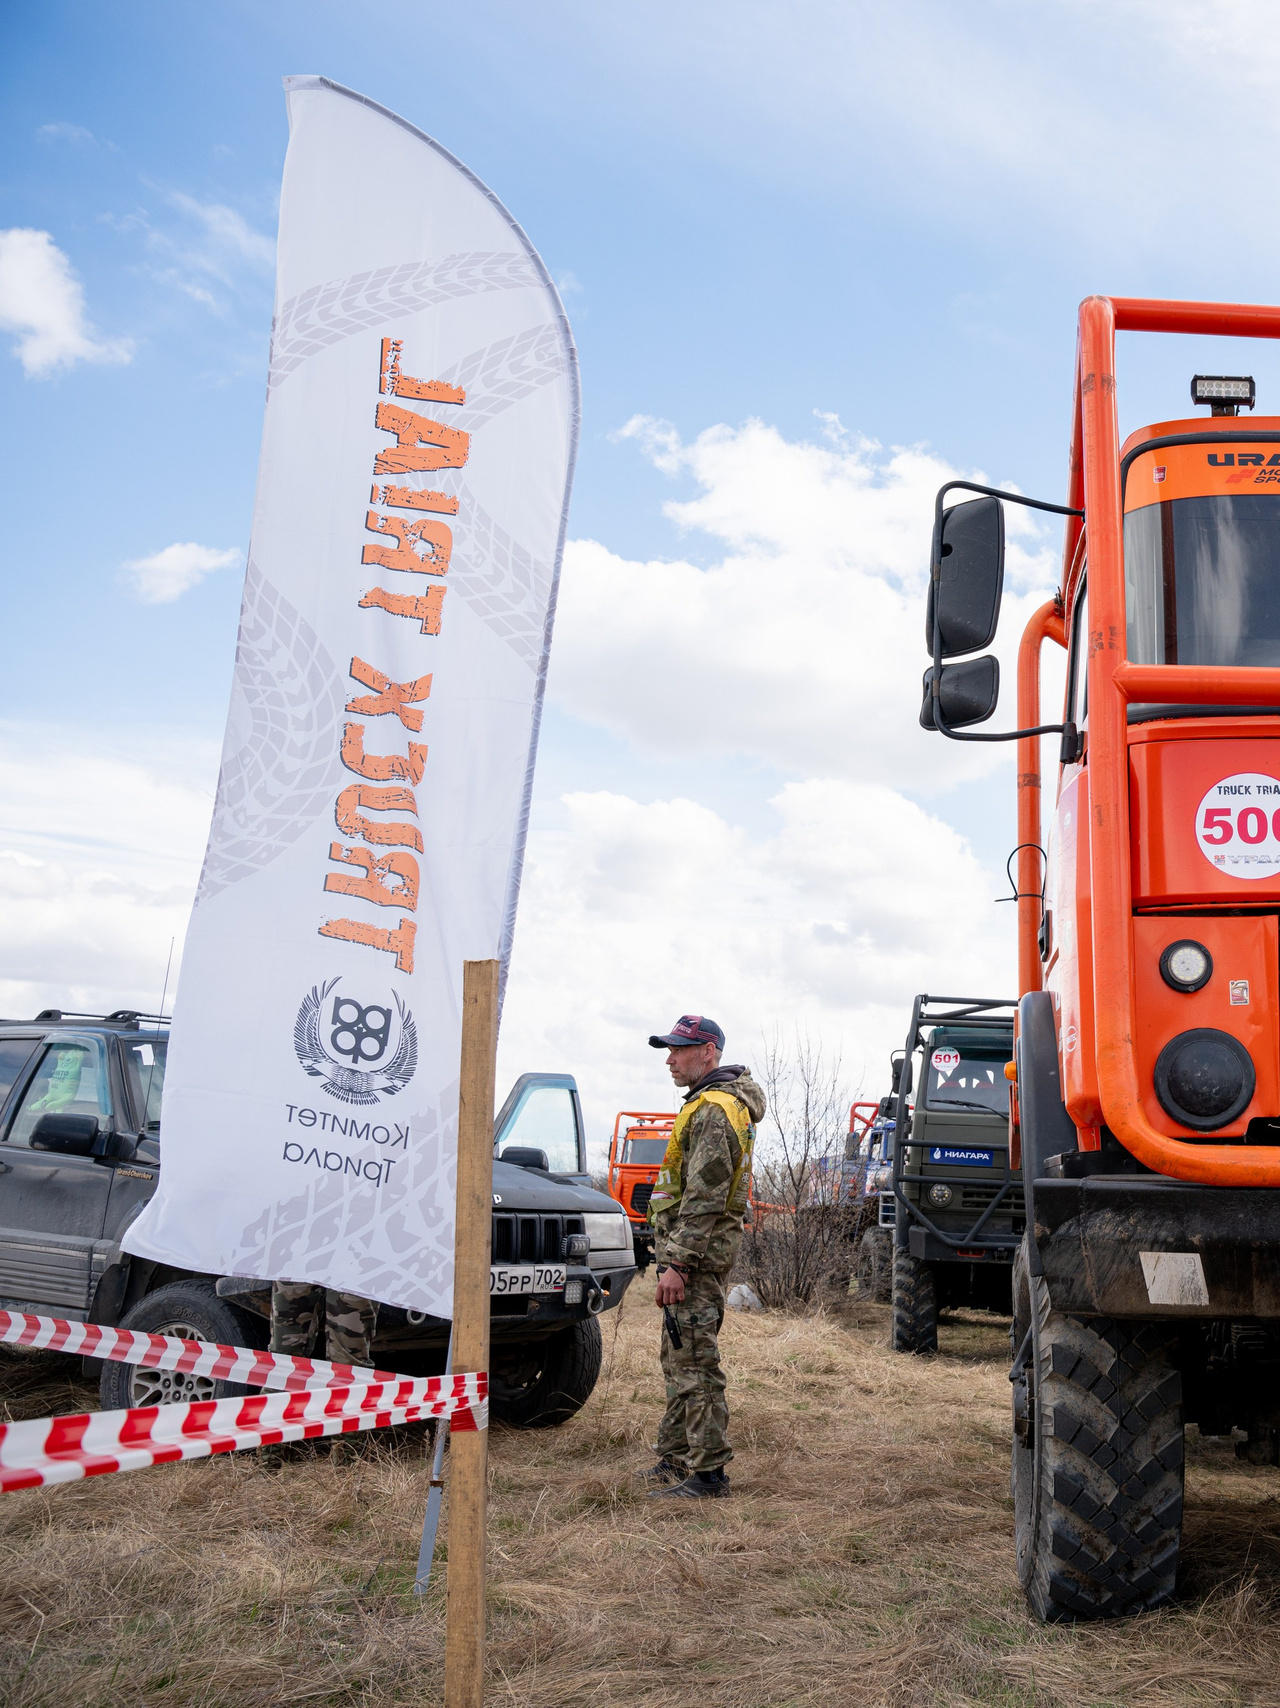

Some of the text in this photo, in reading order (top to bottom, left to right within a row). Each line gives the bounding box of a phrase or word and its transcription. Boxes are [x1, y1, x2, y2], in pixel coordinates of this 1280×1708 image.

[1217, 785, 1252, 795] TRUCK
[934, 1053, 958, 1064] 501
[944, 1150, 989, 1160] НИАГАРА
[536, 1269, 563, 1285] 702
